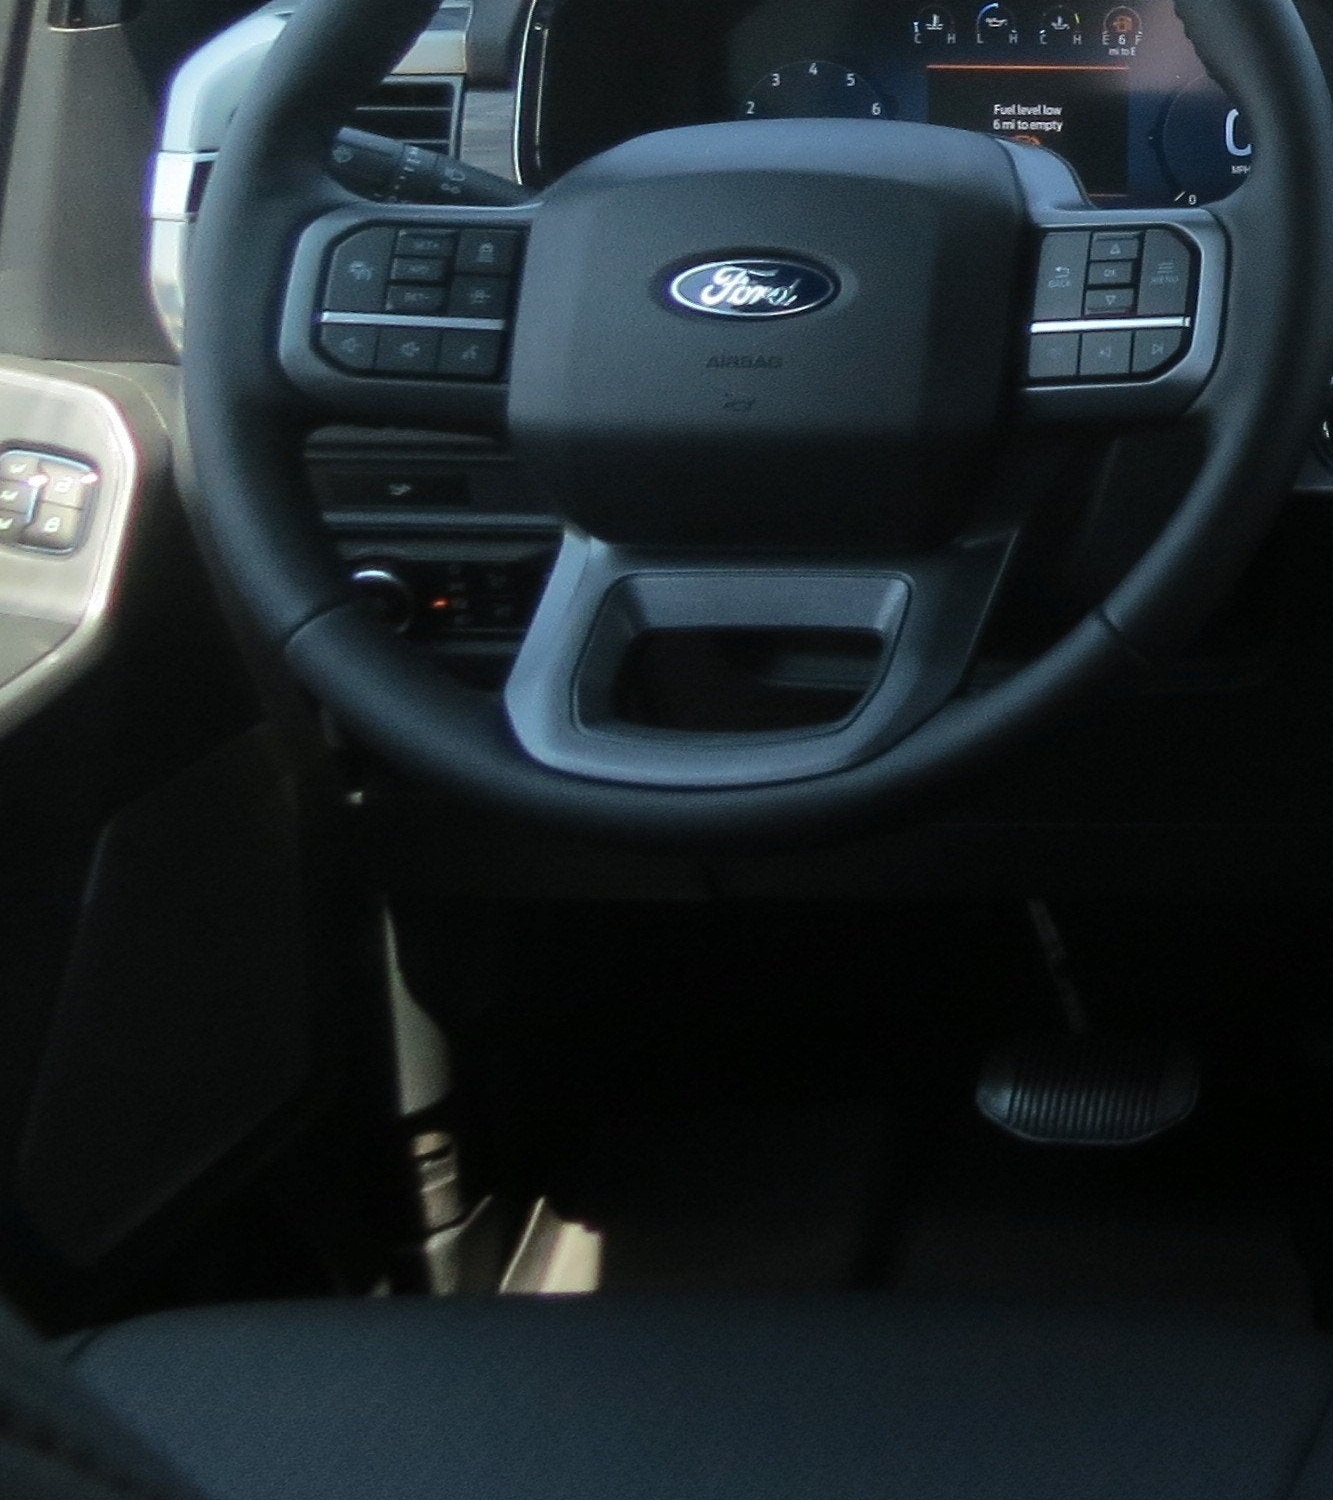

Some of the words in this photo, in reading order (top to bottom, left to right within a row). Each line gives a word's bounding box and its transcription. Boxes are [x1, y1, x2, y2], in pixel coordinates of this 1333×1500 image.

[807, 61, 818, 75] 4
[771, 72, 781, 87] 3
[845, 72, 856, 87] 5
[746, 100, 756, 115] 2
[871, 101, 881, 116] 6
[993, 103, 1016, 116] Fuel
[1016, 103, 1042, 116] level
[1042, 103, 1062, 116] low
[992, 118, 1001, 131] 6
[1002, 118, 1016, 131] mi
[1017, 118, 1029, 131] to
[1029, 120, 1063, 133] empty
[705, 355, 783, 370] AIRBAG
